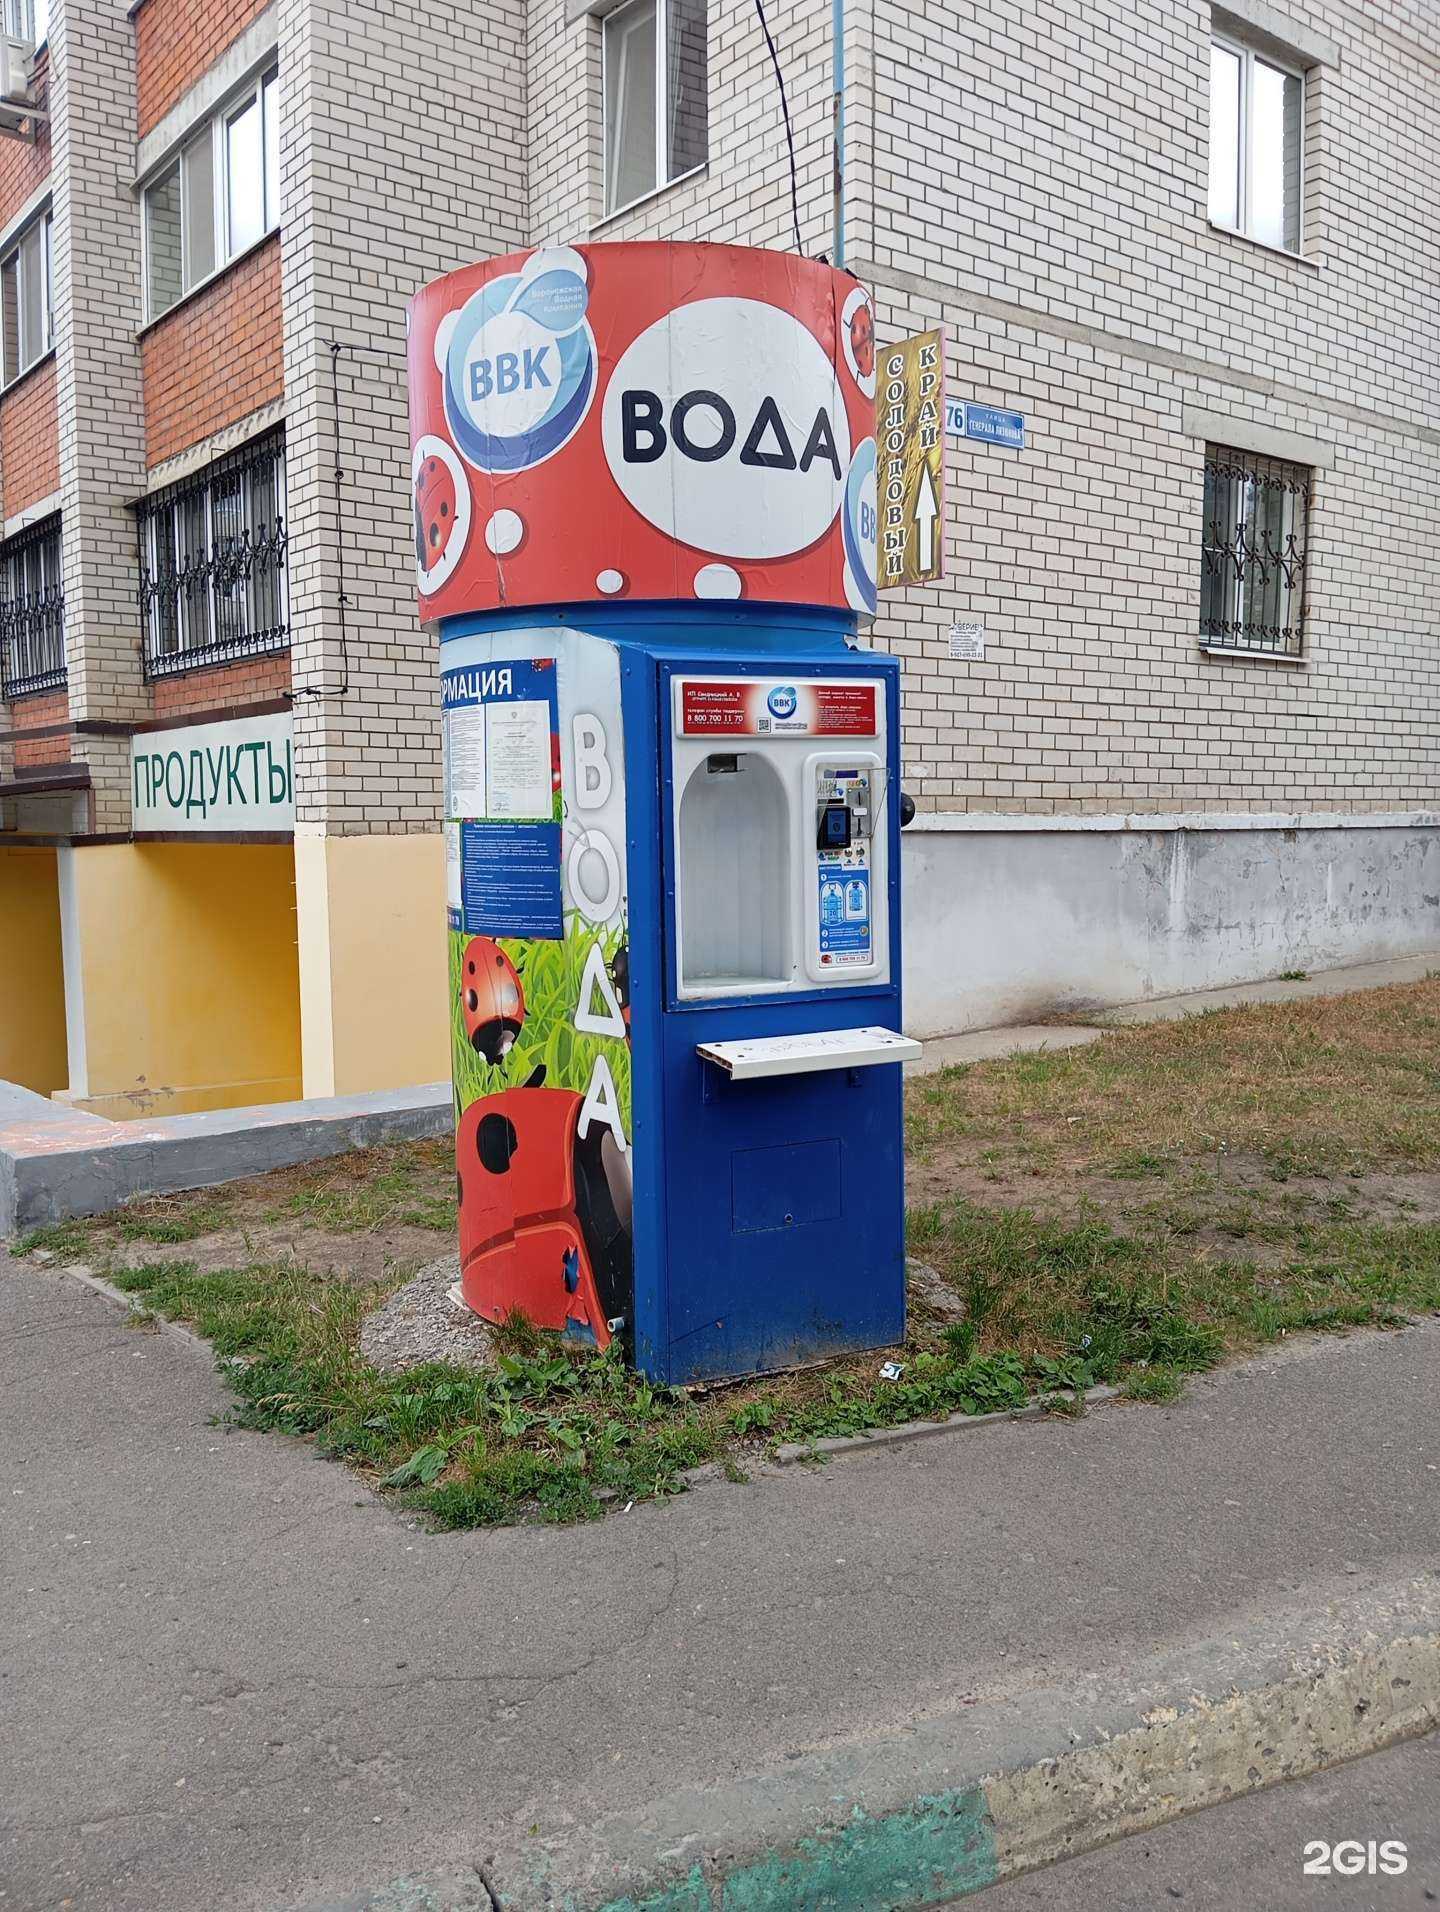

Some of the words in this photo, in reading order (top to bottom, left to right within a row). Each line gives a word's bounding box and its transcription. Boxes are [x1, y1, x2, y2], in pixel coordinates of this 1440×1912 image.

[470, 344, 552, 402] ВВК
[919, 344, 937, 450] КРАЙ
[622, 390, 842, 481] ВОДА
[945, 406, 963, 429] 76
[687, 714, 692, 722] 8
[694, 714, 707, 722] 800
[709, 714, 722, 722] 700
[724, 714, 732, 722] 11
[734, 714, 743, 722] 70
[774, 698, 790, 707] ВВК
[134, 738, 293, 819] ПРОДУКТЫ
